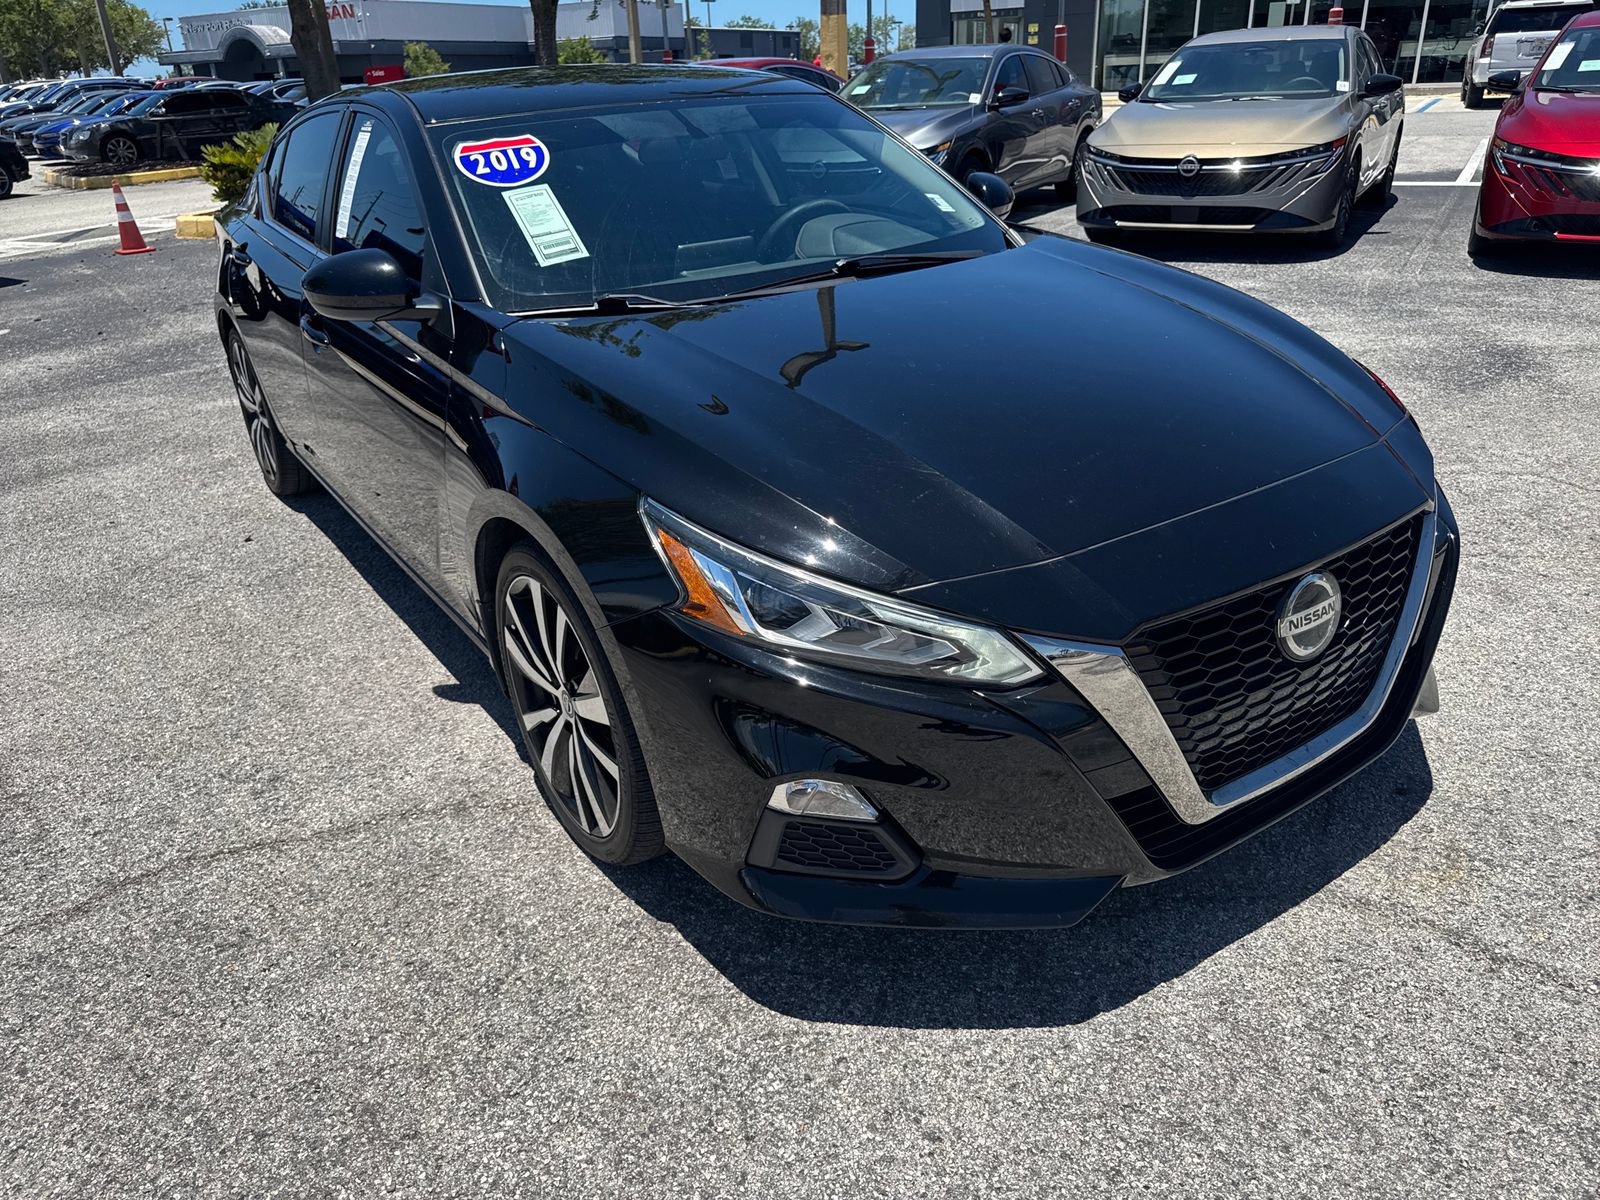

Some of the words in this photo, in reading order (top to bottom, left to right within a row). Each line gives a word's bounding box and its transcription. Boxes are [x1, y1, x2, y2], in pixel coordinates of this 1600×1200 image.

[186, 23, 205, 33] New
[206, 21, 224, 32] Port
[469, 147, 537, 175] 2019
[1288, 601, 1335, 632] NISSAN
